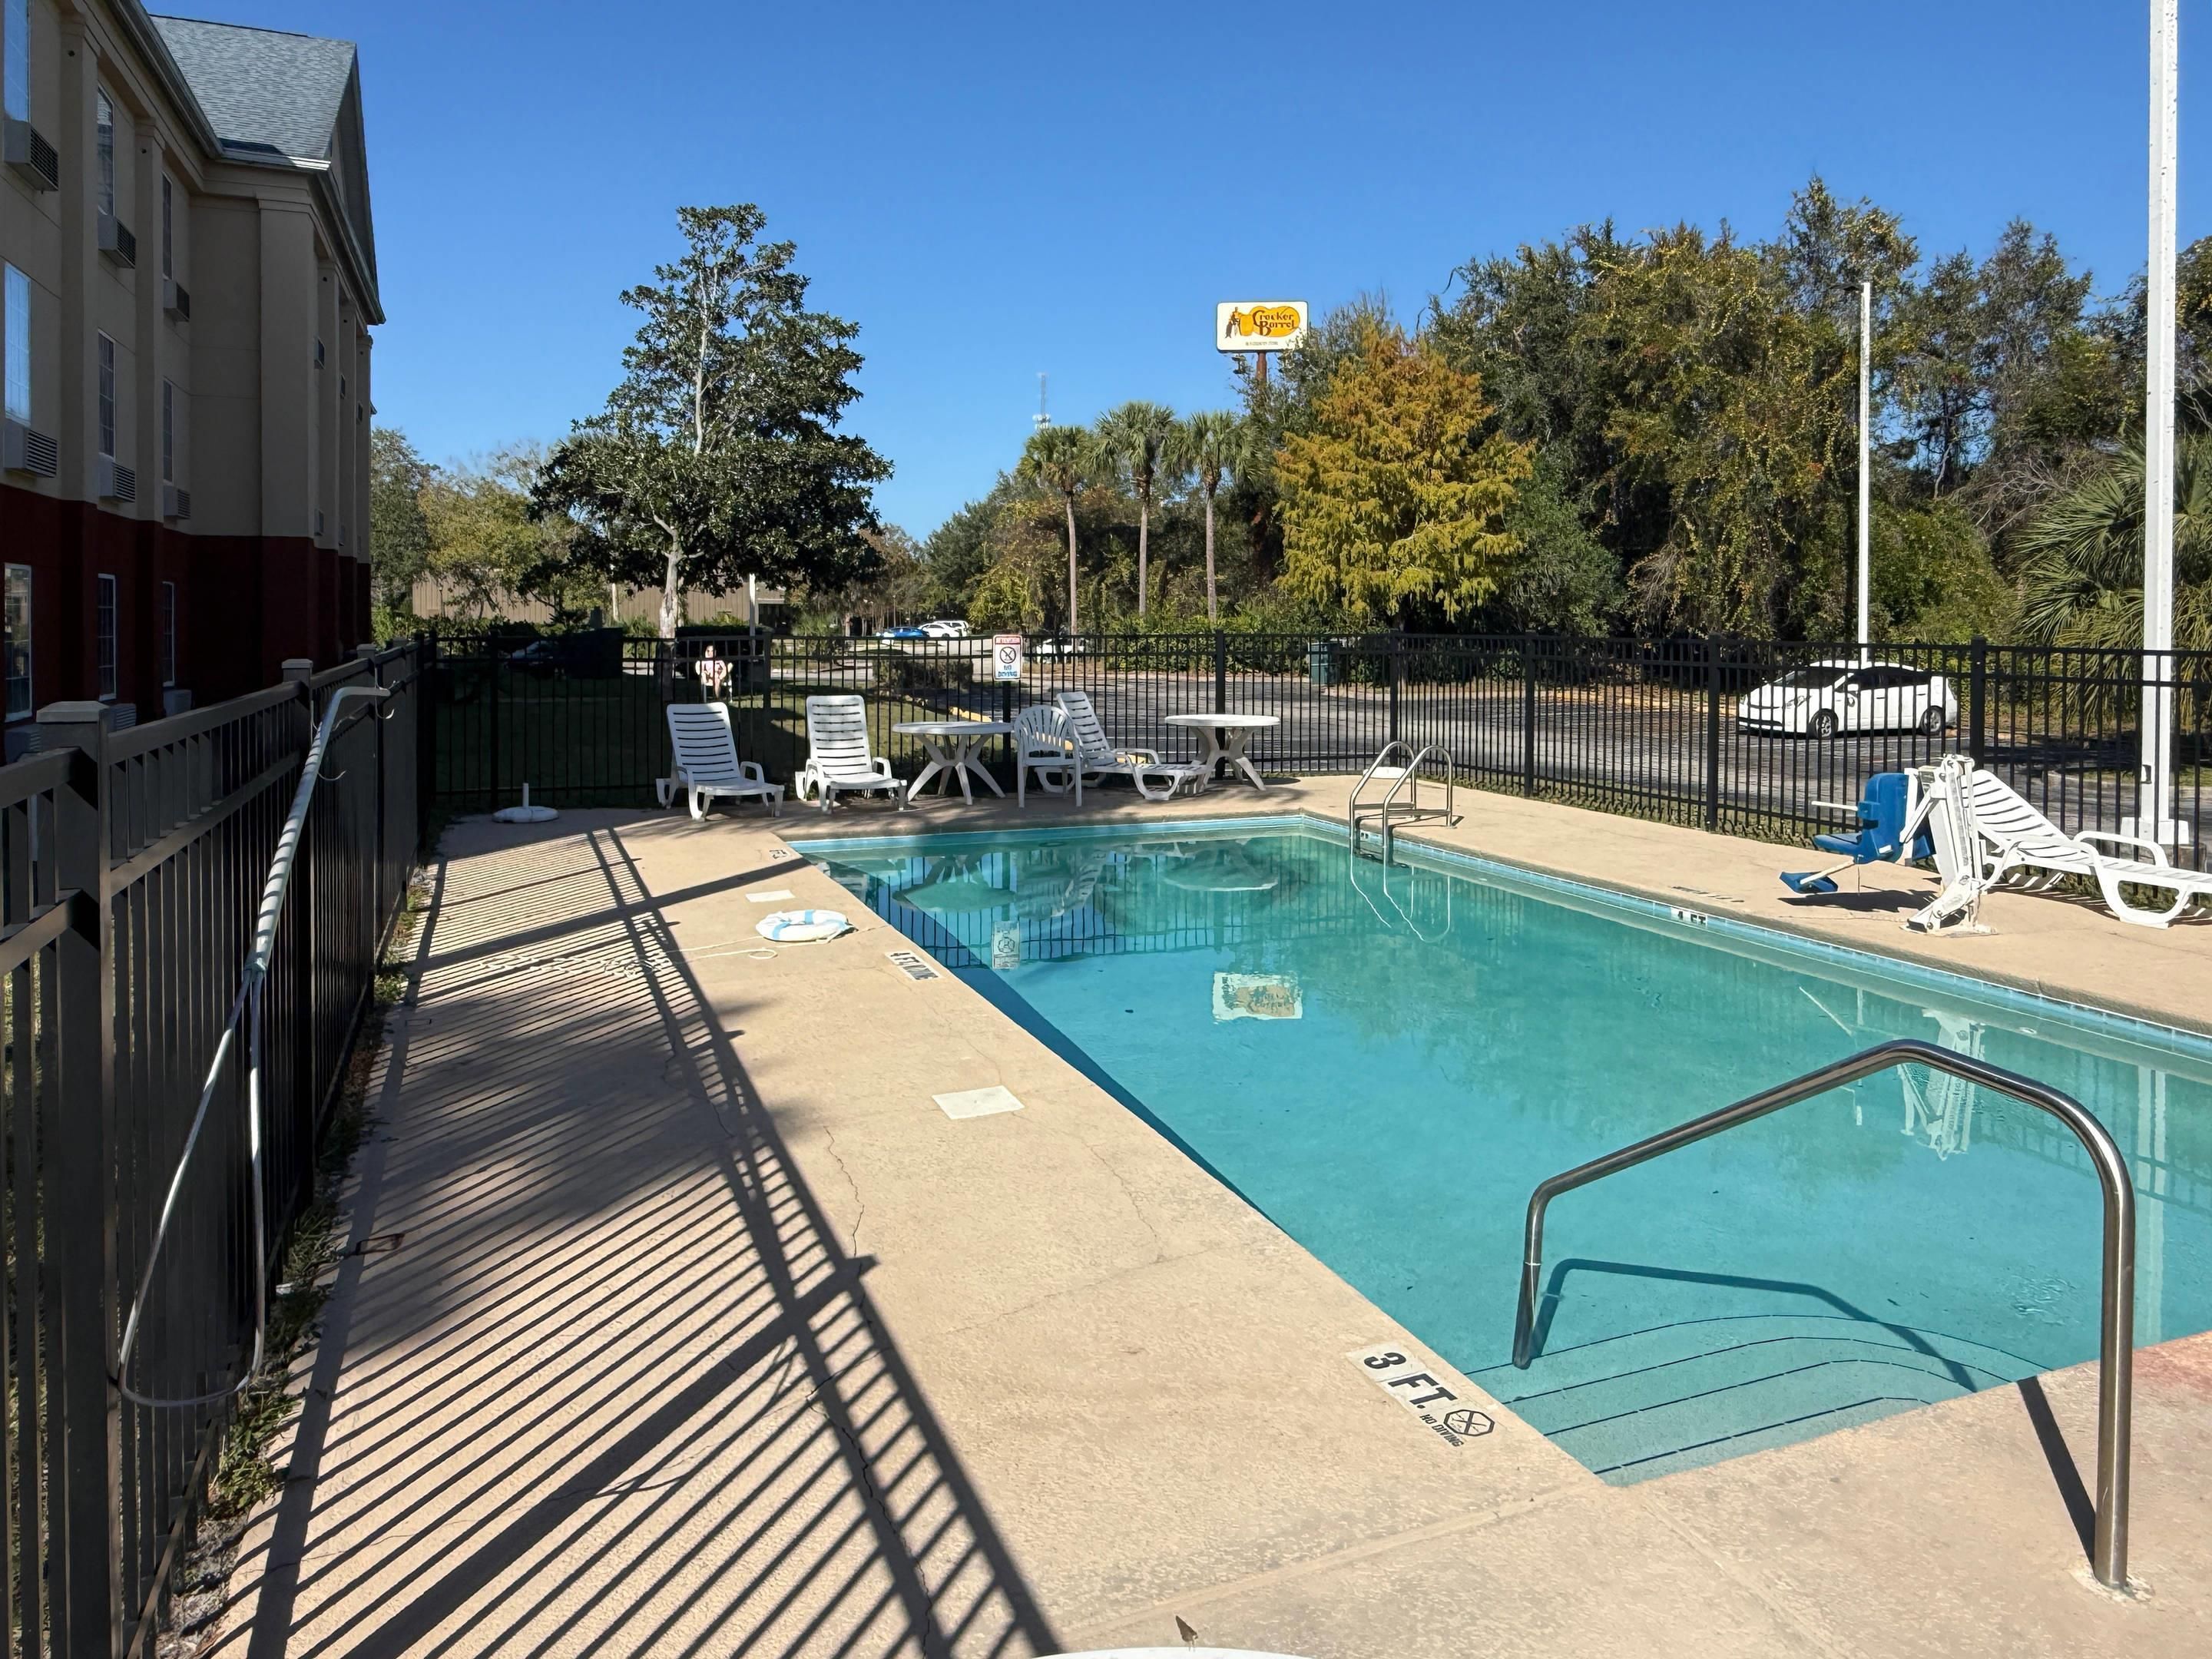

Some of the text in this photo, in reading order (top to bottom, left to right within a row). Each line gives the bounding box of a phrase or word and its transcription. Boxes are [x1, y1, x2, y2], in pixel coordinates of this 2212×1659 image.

[1253, 310, 1294, 326] Cracker
[1259, 320, 1294, 336] Barrel
[1363, 1352, 1458, 1409] 3 FT.
[1419, 1414, 1464, 1447] NO DIVING
